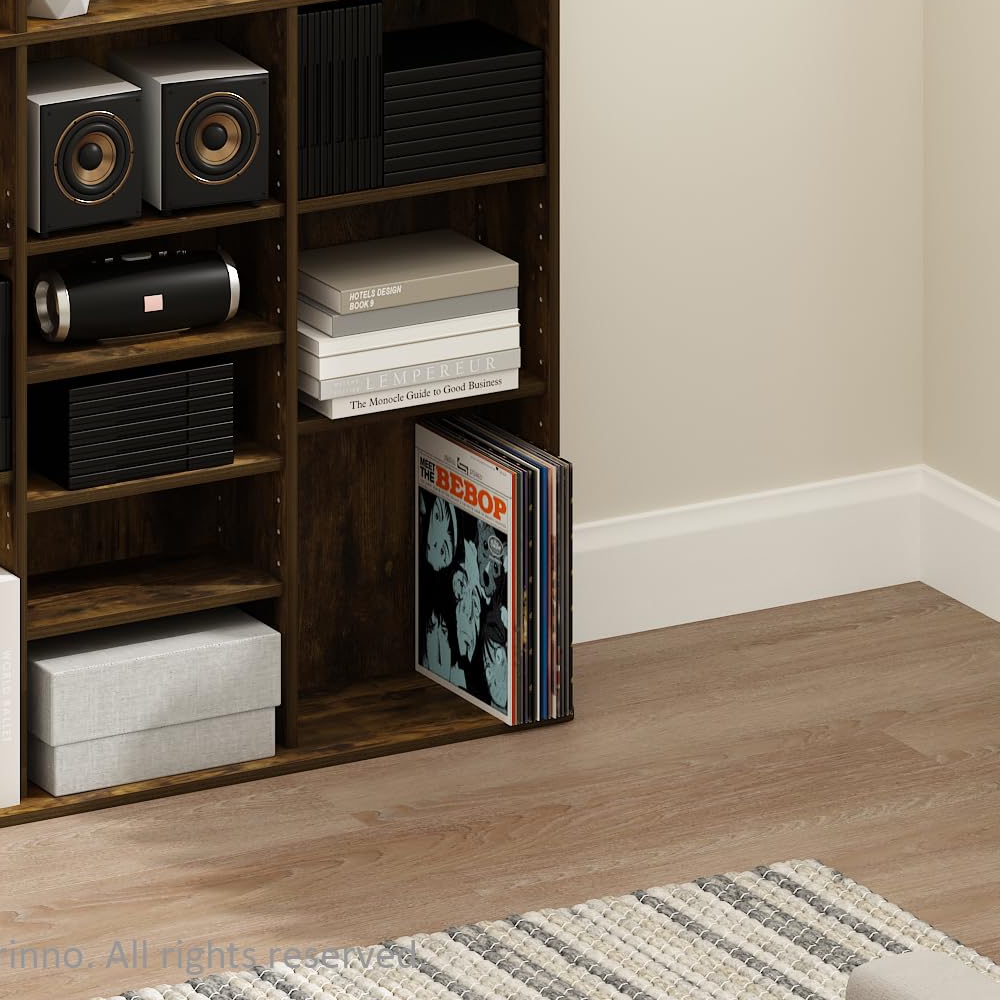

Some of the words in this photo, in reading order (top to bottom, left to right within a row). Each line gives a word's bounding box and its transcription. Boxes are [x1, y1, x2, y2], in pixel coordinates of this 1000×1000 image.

[349, 289, 376, 301] HOTELS
[376, 284, 402, 297] DESIGN
[349, 300, 369, 310] BOOK
[349, 400, 367, 410] The
[369, 393, 404, 407] Monocle
[406, 388, 431, 401] Guide
[433, 388, 442, 396] to
[443, 382, 466, 394] Good
[468, 378, 503, 390] Business
[420, 457, 436, 471] MEET
[420, 467, 435, 484] THE
[435, 464, 507, 521] BEBOP
